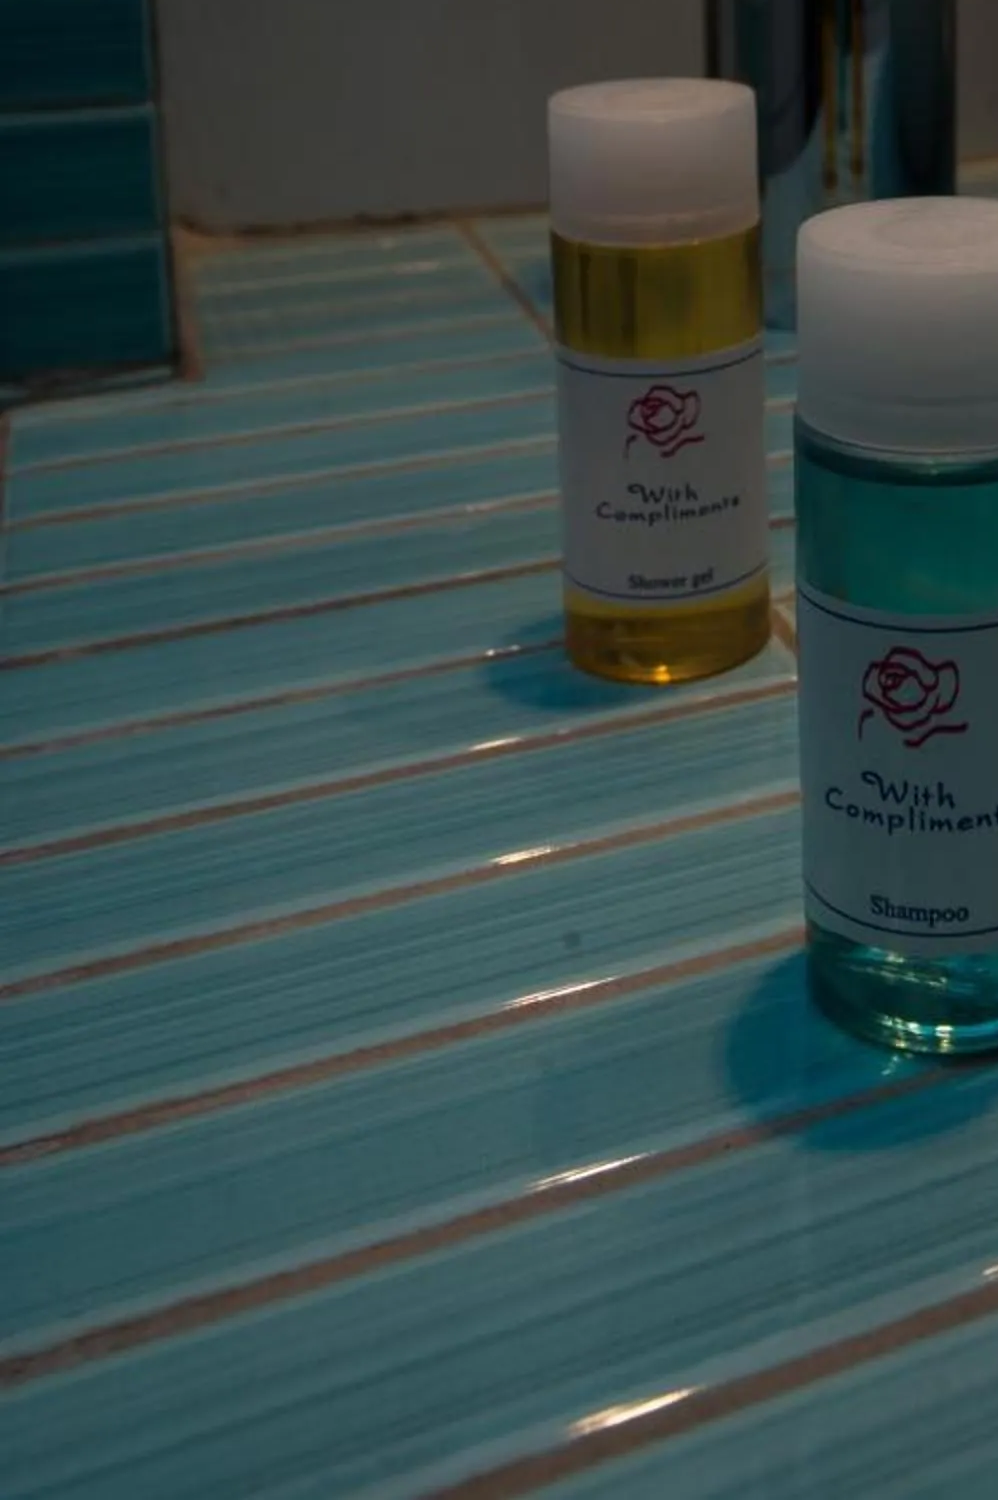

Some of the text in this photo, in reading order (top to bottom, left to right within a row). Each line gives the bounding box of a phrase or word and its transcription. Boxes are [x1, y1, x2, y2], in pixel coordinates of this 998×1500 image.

[627, 482, 699, 504] With
[596, 495, 740, 527] Compliments
[627, 567, 714, 590] Shower gel
[860, 770, 956, 809] With
[869, 894, 970, 928] Shampoo
